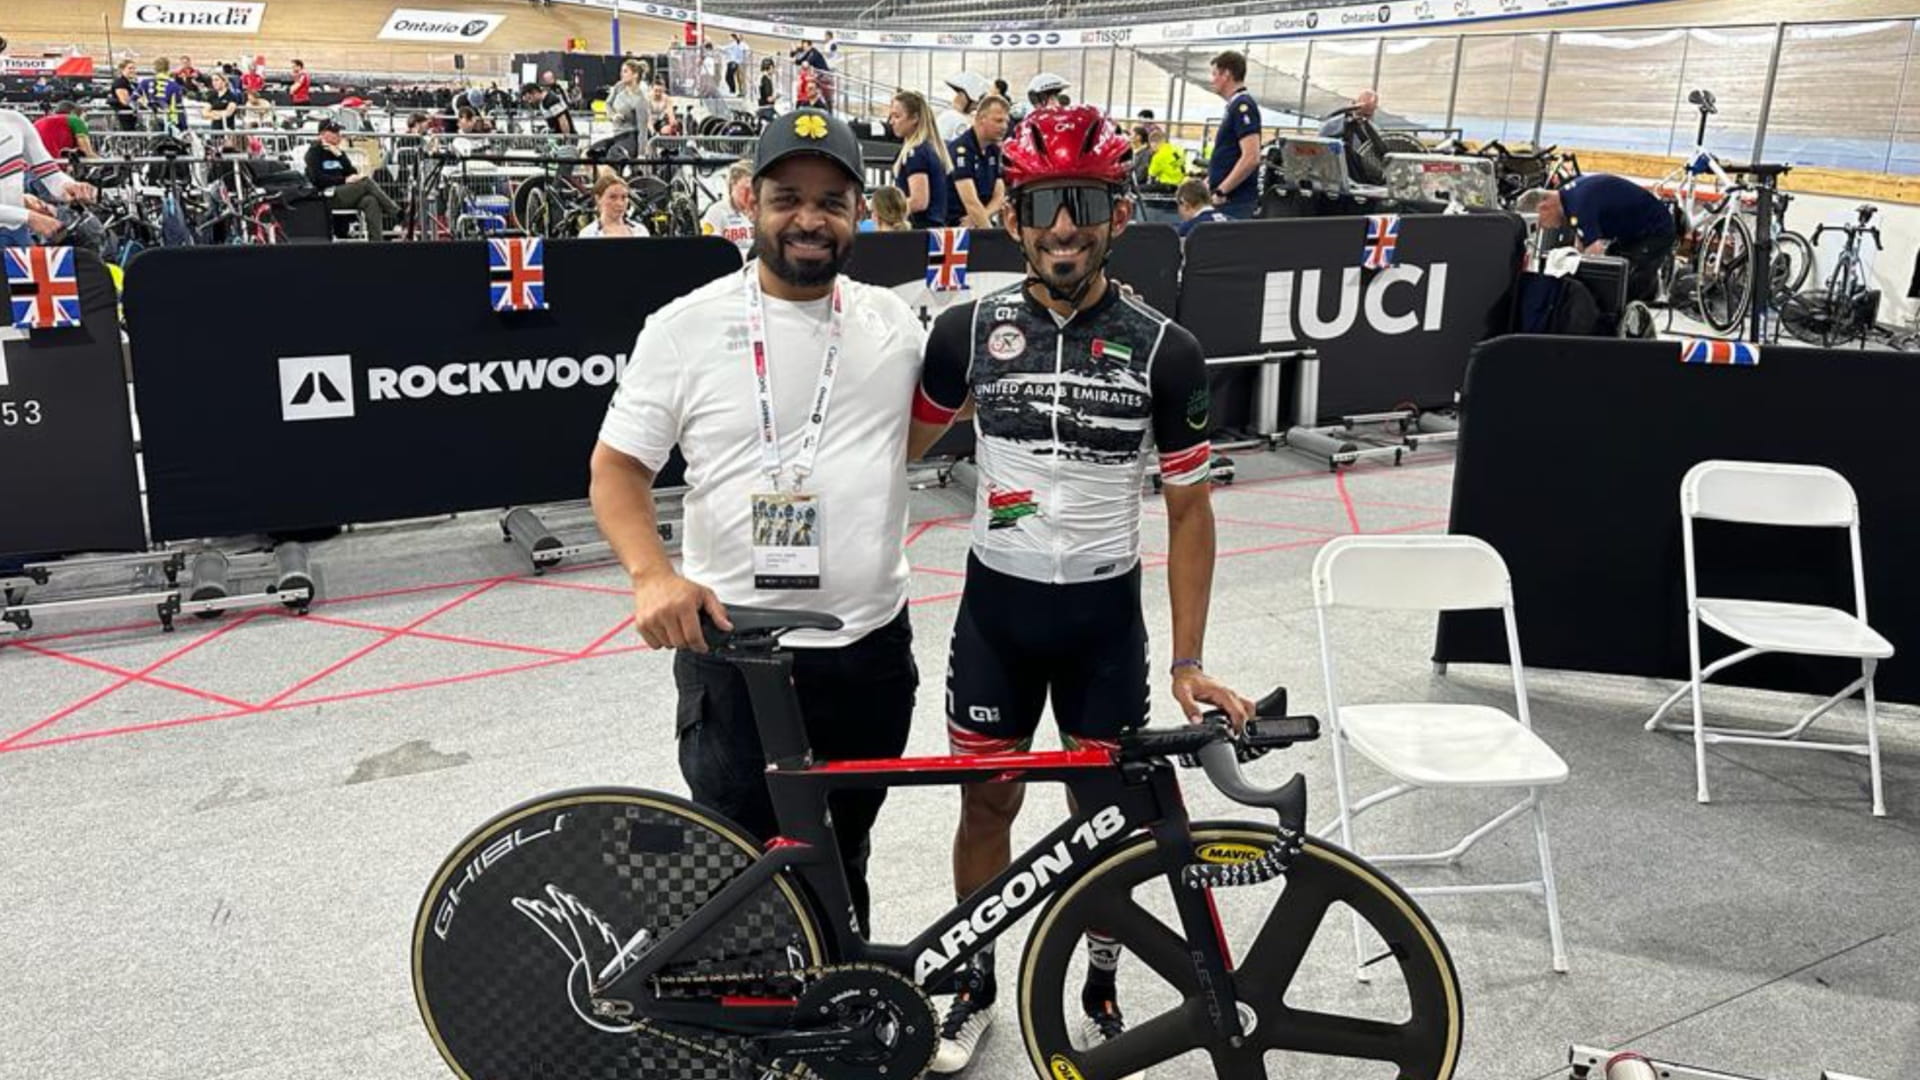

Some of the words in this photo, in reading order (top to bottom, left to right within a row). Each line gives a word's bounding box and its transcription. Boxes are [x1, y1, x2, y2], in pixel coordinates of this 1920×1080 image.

[136, 4, 249, 25] Canada
[393, 20, 459, 33] Ontario
[1095, 29, 1133, 43] TISSOT
[4, 59, 46, 68] TISSOT
[975, 381, 1019, 396] UNITED
[1023, 384, 1068, 398] ARAB
[1072, 388, 1143, 408] EMIRATES
[1208, 848, 1257, 860] MAVIC
[914, 840, 1074, 985] ARGON
[1071, 805, 1126, 850] 18
